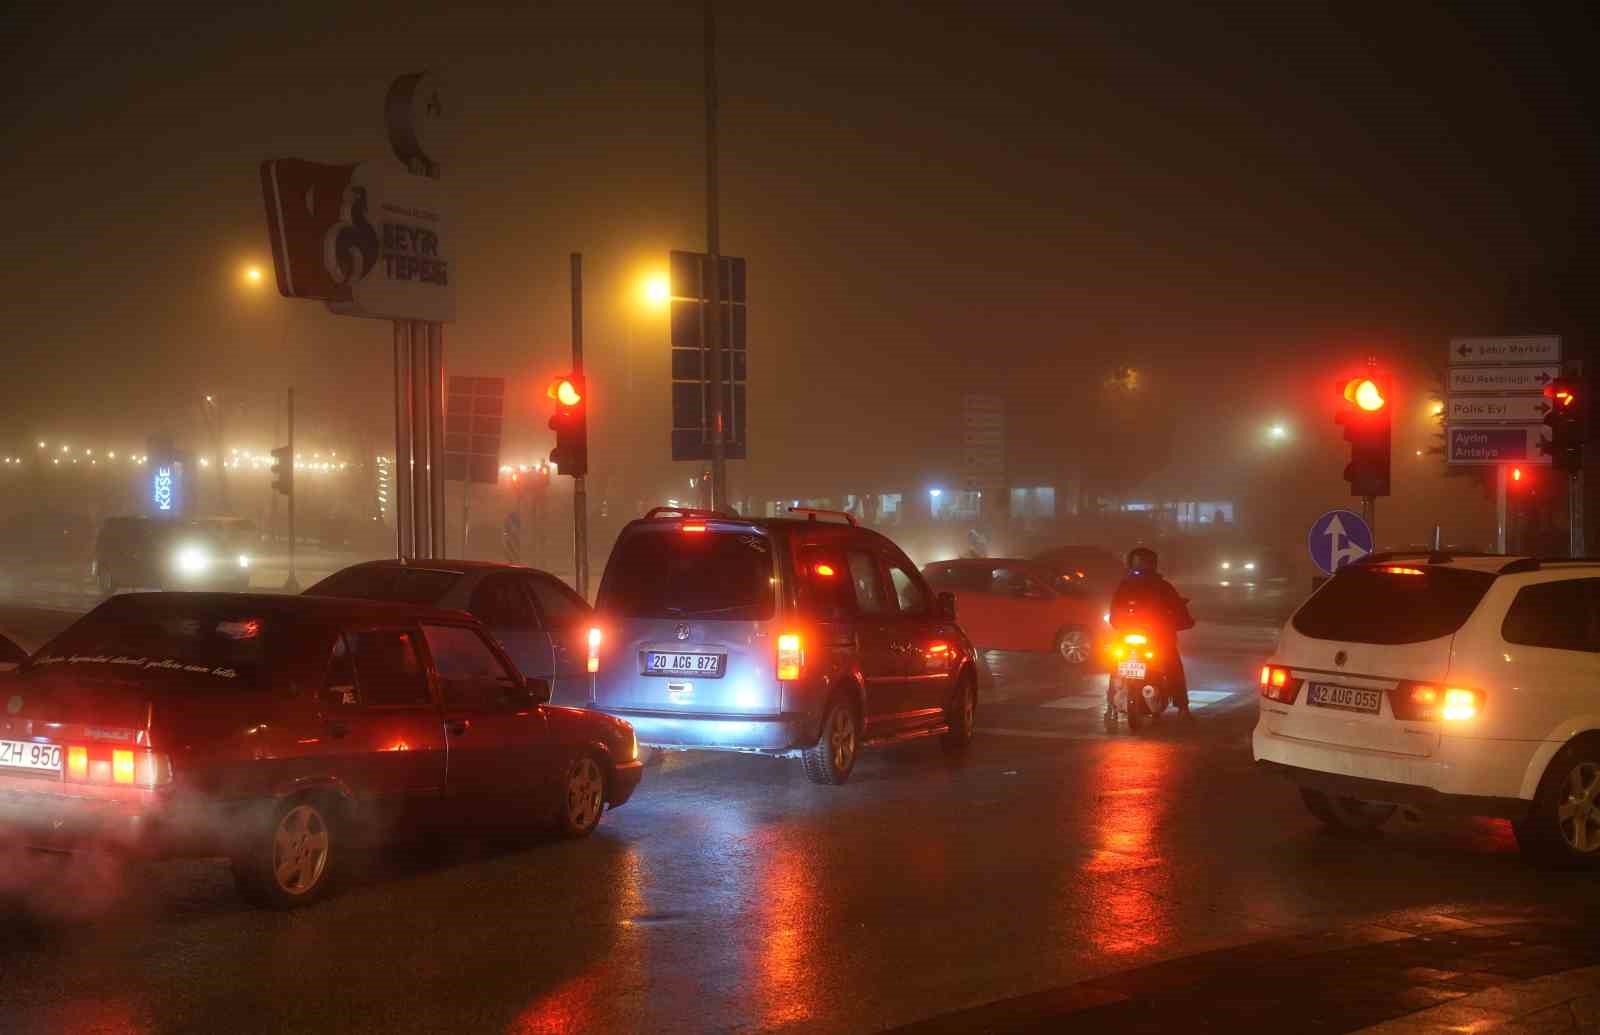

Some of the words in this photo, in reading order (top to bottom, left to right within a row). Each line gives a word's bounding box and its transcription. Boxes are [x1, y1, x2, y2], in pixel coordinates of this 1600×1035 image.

[653, 655, 667, 668] 20
[672, 655, 692, 669] ACG
[697, 656, 717, 670] 872
[1331, 689, 1352, 705] AUG
[1354, 692, 1378, 709] 055
[30, 745, 61, 767] 950
